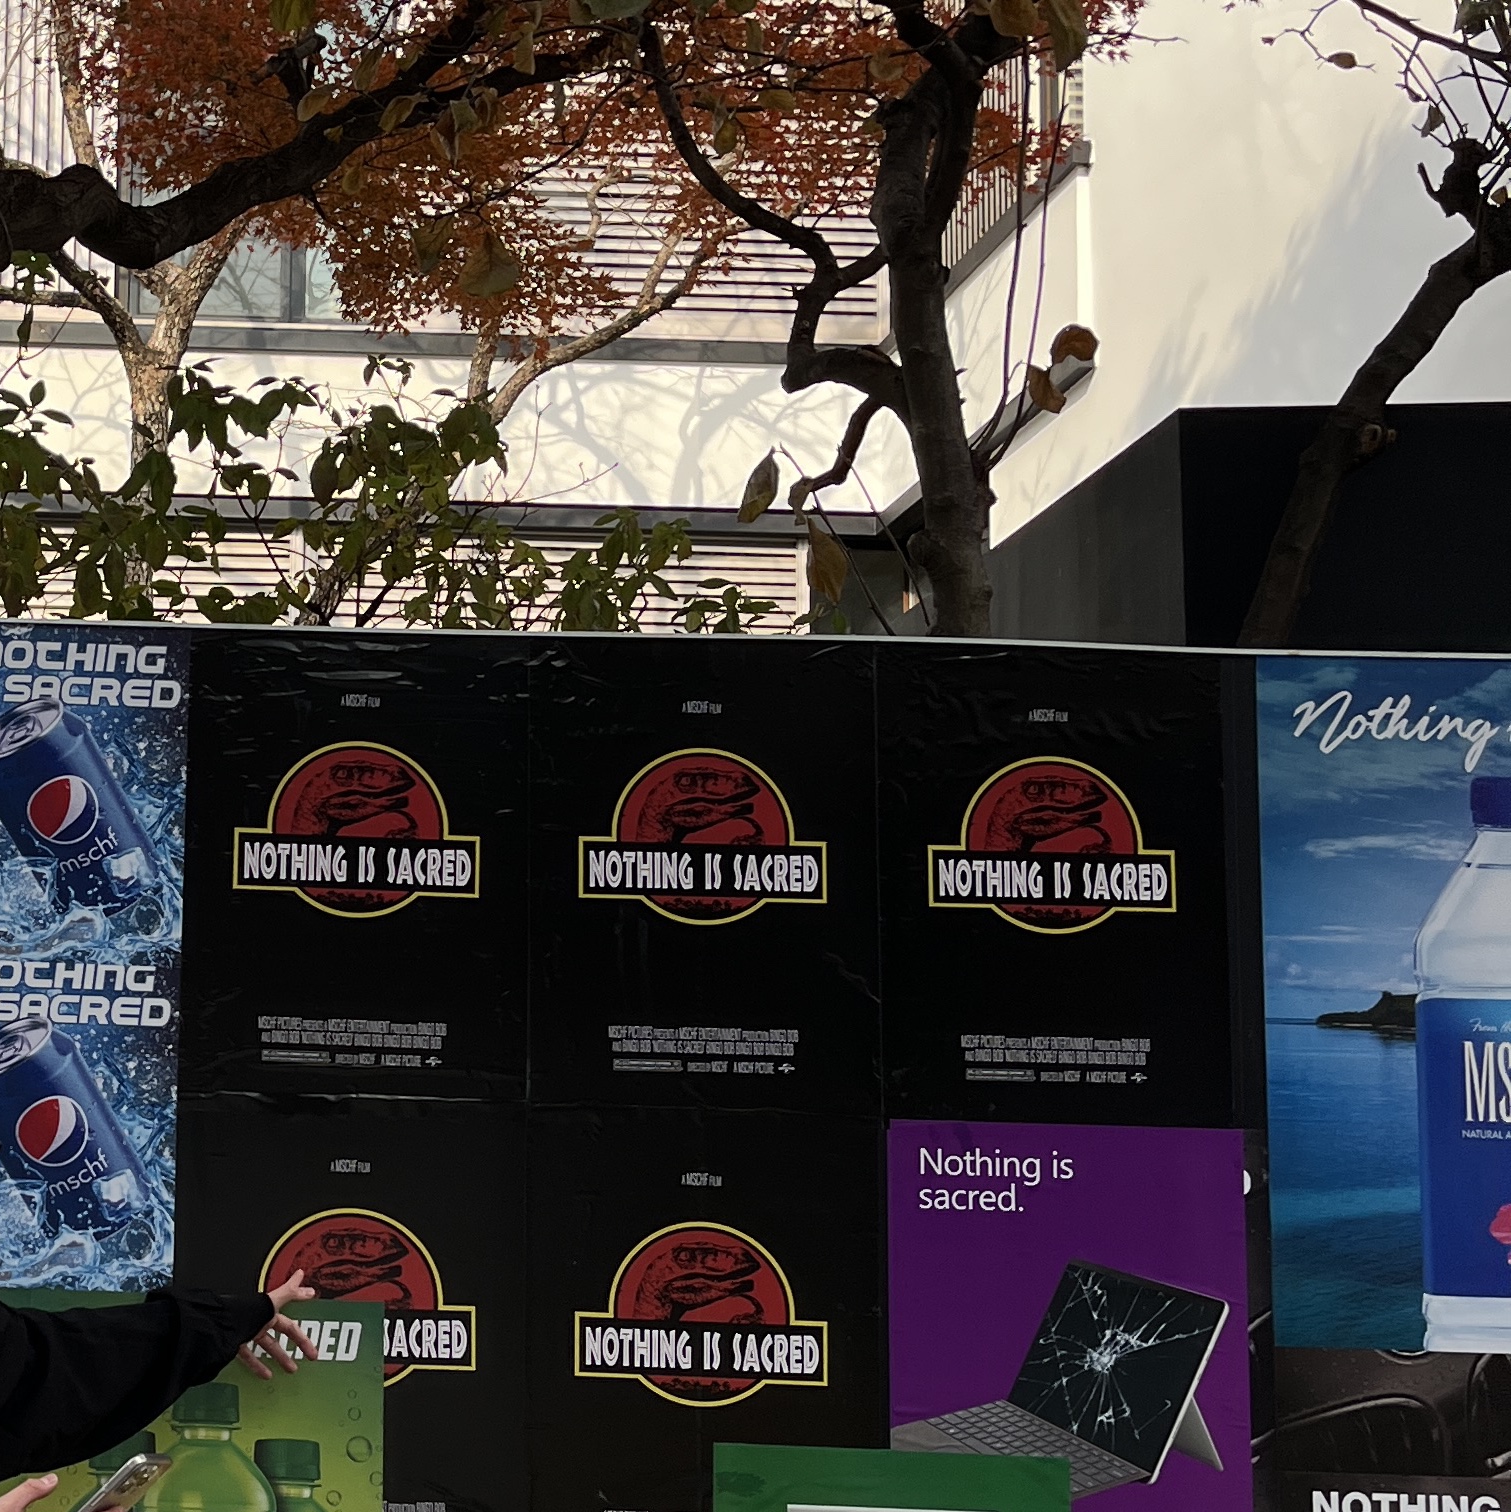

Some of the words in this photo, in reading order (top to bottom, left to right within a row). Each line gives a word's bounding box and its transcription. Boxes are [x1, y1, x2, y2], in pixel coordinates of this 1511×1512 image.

[3, 674, 181, 708] SACRED
[1293, 690, 1500, 773] Nothing
[59, 826, 119, 876] mschf
[243, 841, 347, 883] NOTHING
[358, 847, 375, 883] IS
[387, 847, 472, 886] SACRED
[589, 850, 693, 890] NOTHING
[705, 853, 722, 891] IS
[734, 854, 819, 893] SACRED
[938, 859, 1043, 899] NOTHING
[1054, 861, 1071, 899] IS
[1083, 862, 1168, 901] SACRED
[1462, 1129, 1503, 1140] NATURAL
[48, 1151, 108, 1198] mschf
[919, 1148, 1041, 1186] Nothing
[1052, 1150, 1074, 1179] is
[918, 1183, 1024, 1212] sacred.
[585, 1325, 692, 1369] NOTHING
[703, 1331, 721, 1370] IS
[733, 1333, 820, 1375] SACRED
